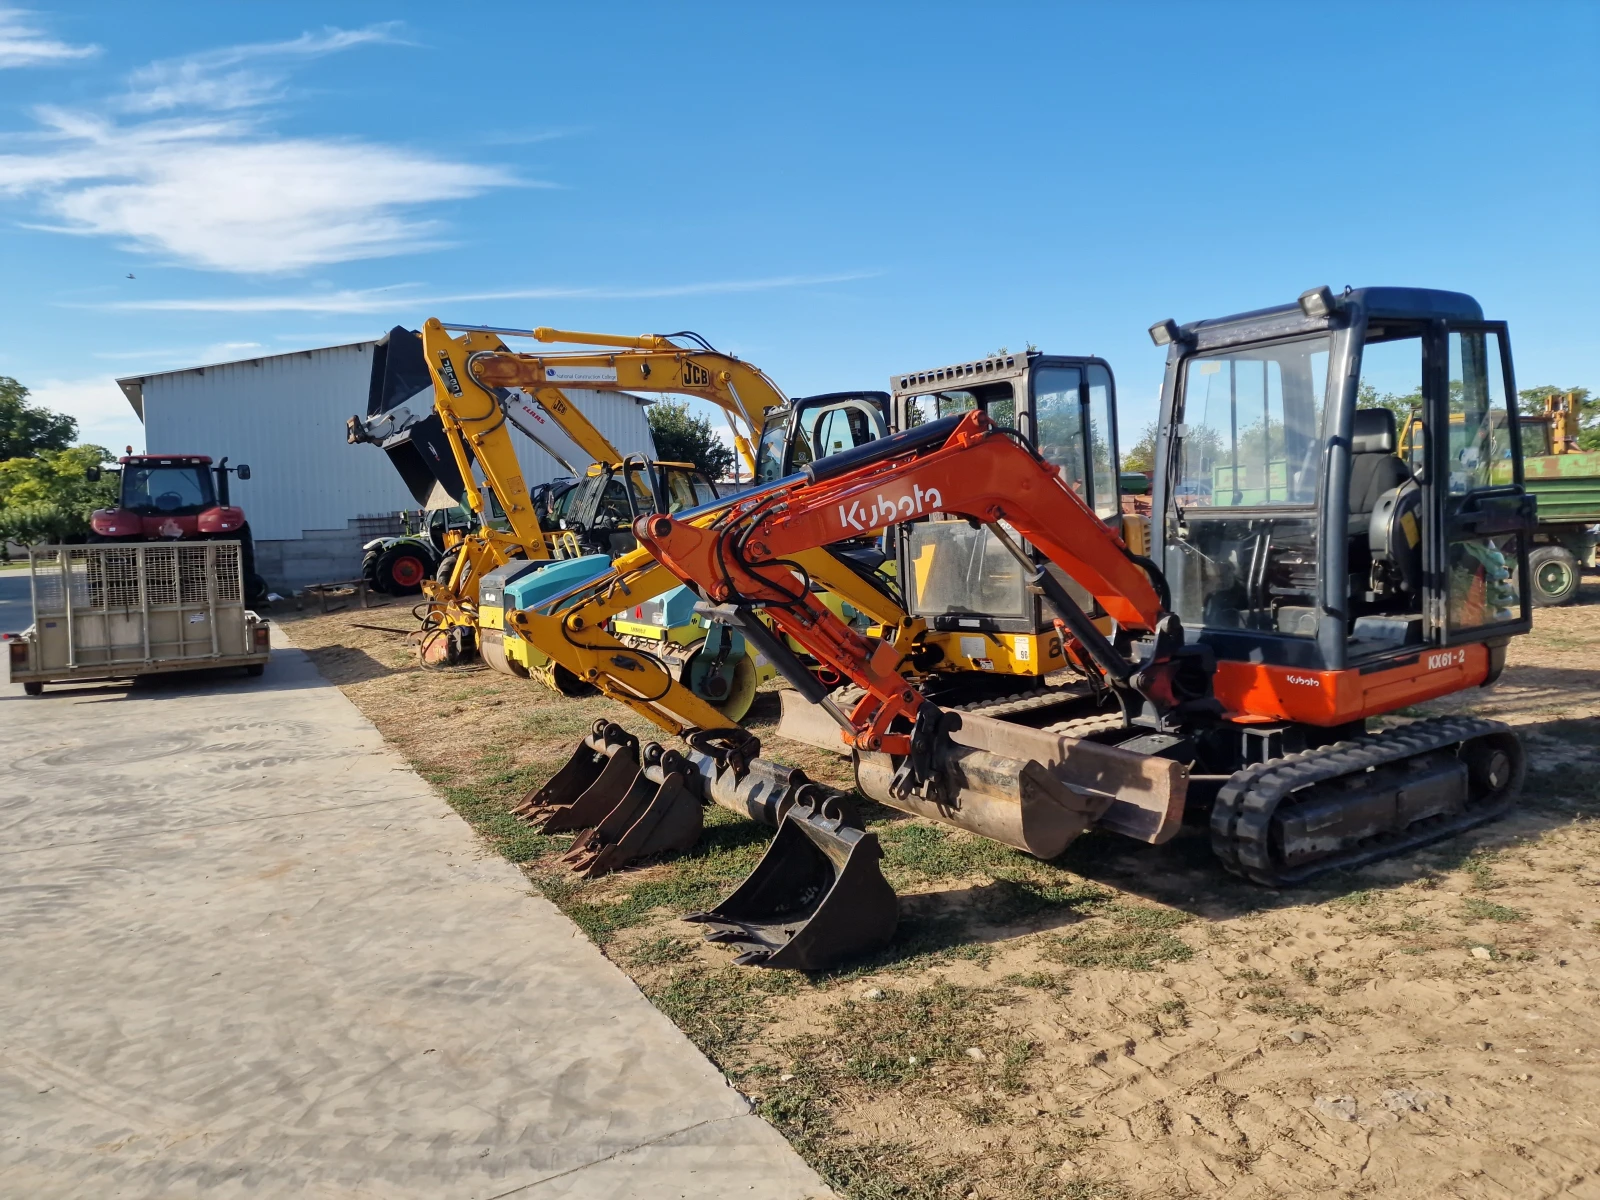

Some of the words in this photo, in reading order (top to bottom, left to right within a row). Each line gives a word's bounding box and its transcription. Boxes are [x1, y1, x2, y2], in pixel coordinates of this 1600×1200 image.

[683, 360, 708, 385] JCB
[553, 399, 567, 414] JCB
[838, 483, 943, 531] Kubota
[1286, 674, 1320, 688] Kubota
